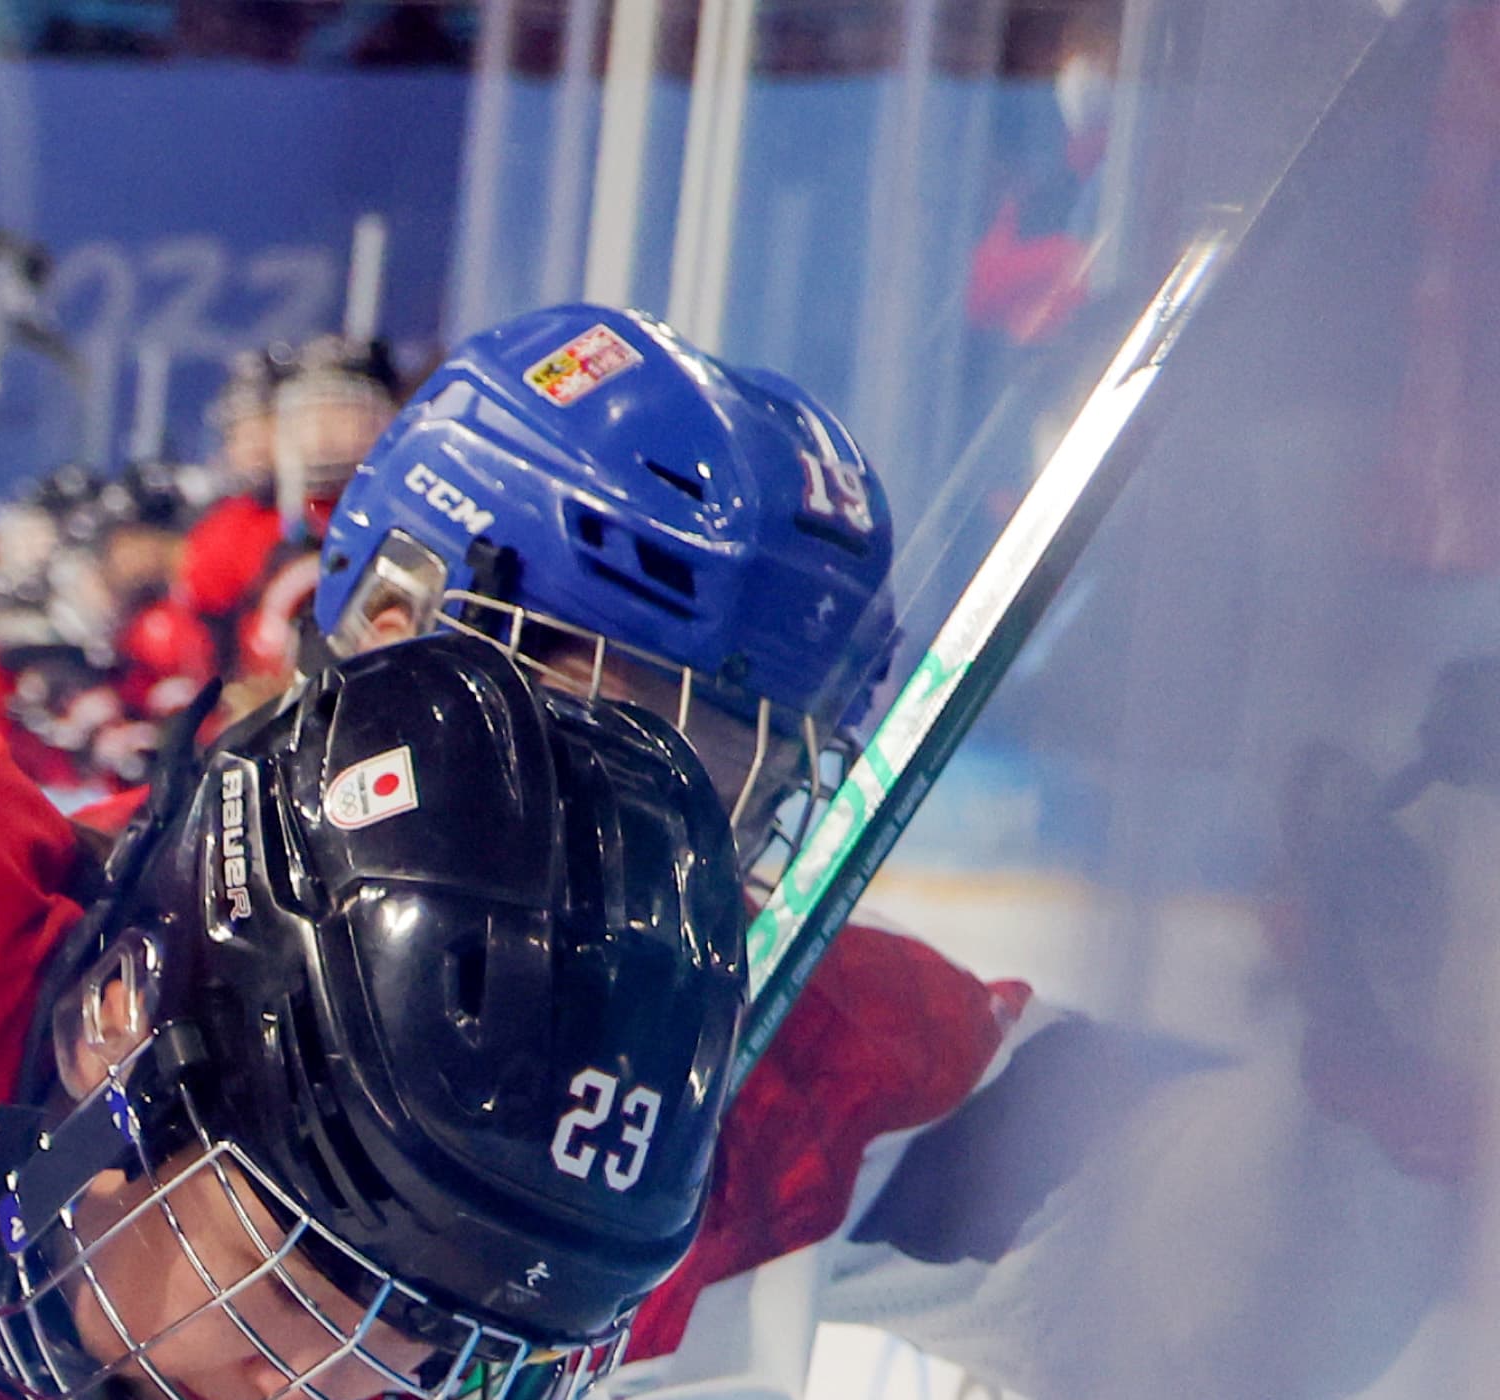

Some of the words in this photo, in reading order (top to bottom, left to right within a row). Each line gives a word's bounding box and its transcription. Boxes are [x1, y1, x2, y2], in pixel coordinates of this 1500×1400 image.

[404, 461, 495, 534] CCM
[220, 769, 253, 922] BAUER
[550, 1068, 662, 1192] 23
